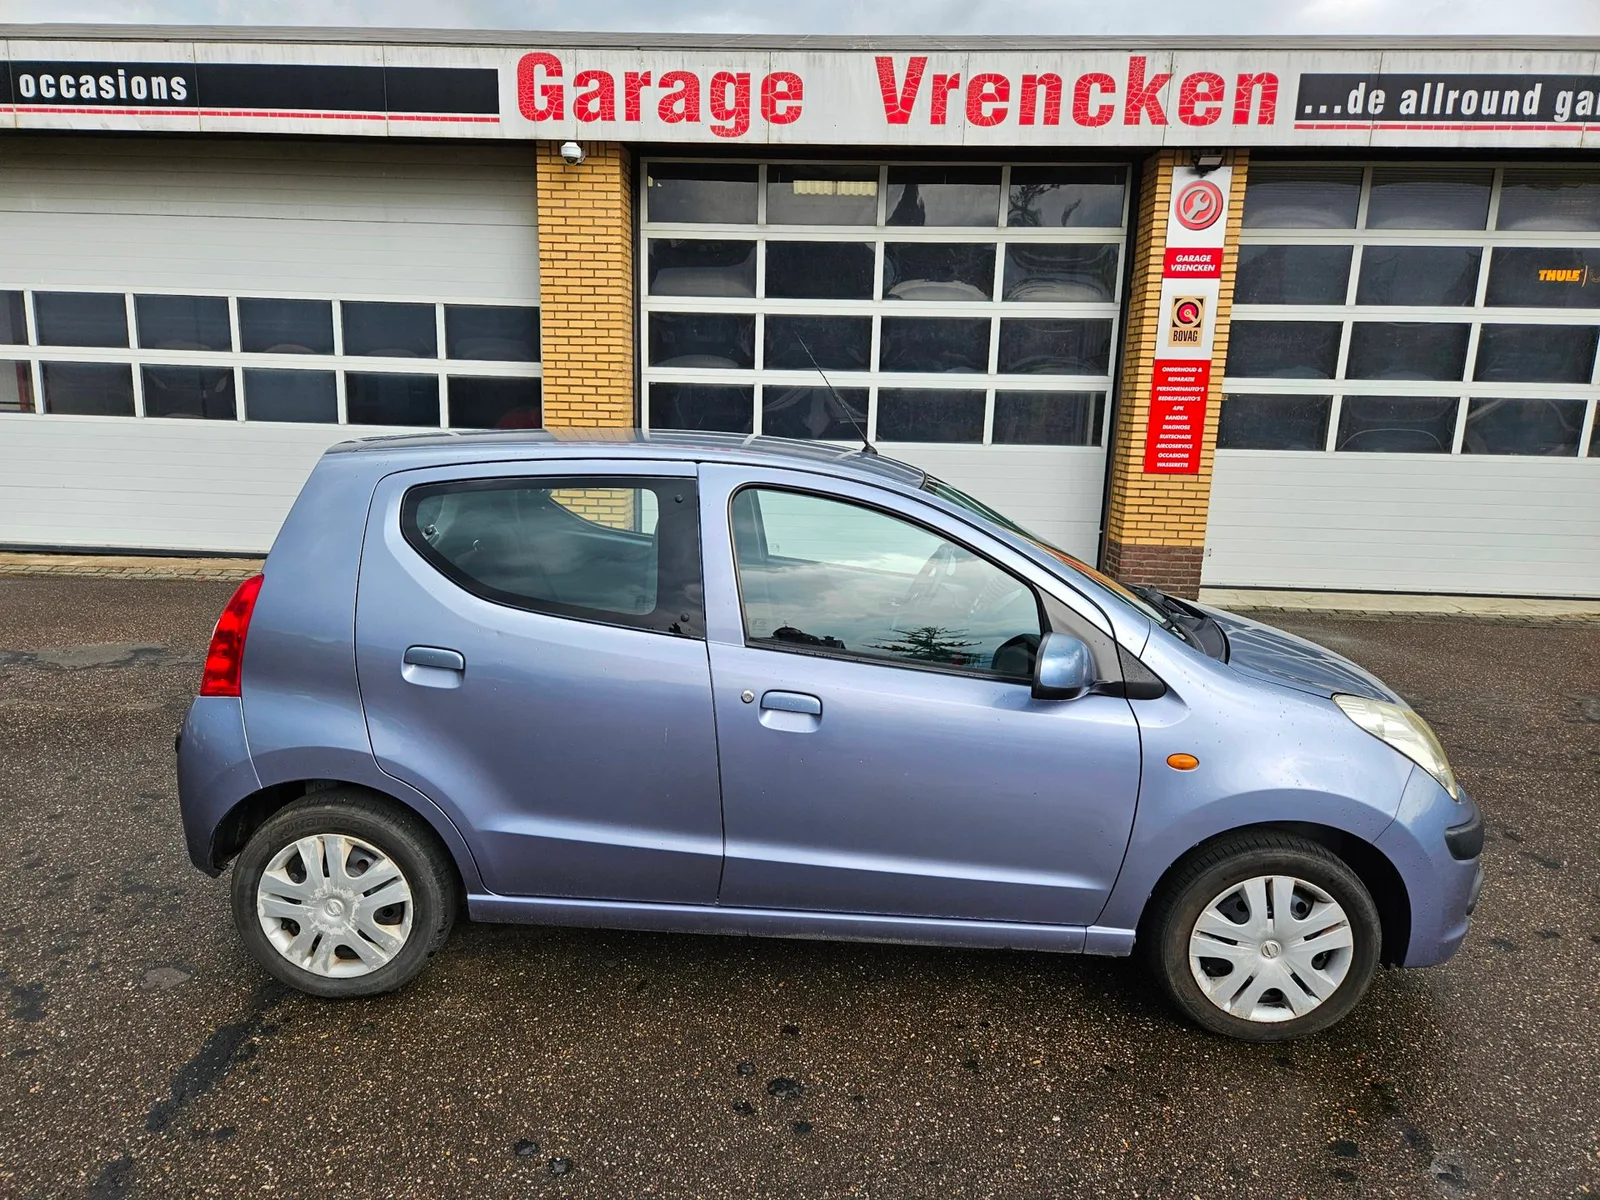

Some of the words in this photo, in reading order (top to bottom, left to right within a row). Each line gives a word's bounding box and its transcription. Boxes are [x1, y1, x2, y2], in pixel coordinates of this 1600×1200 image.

[20, 69, 186, 100] occasions
[517, 52, 803, 137] Garage
[876, 56, 1279, 127] Vrencken
[1400, 83, 1542, 115] allround
[1175, 254, 1212, 263] GARAGE
[1170, 263, 1216, 272] VRENCKEN
[1538, 269, 1582, 282] THULE
[1172, 329, 1199, 343] BOVAG
